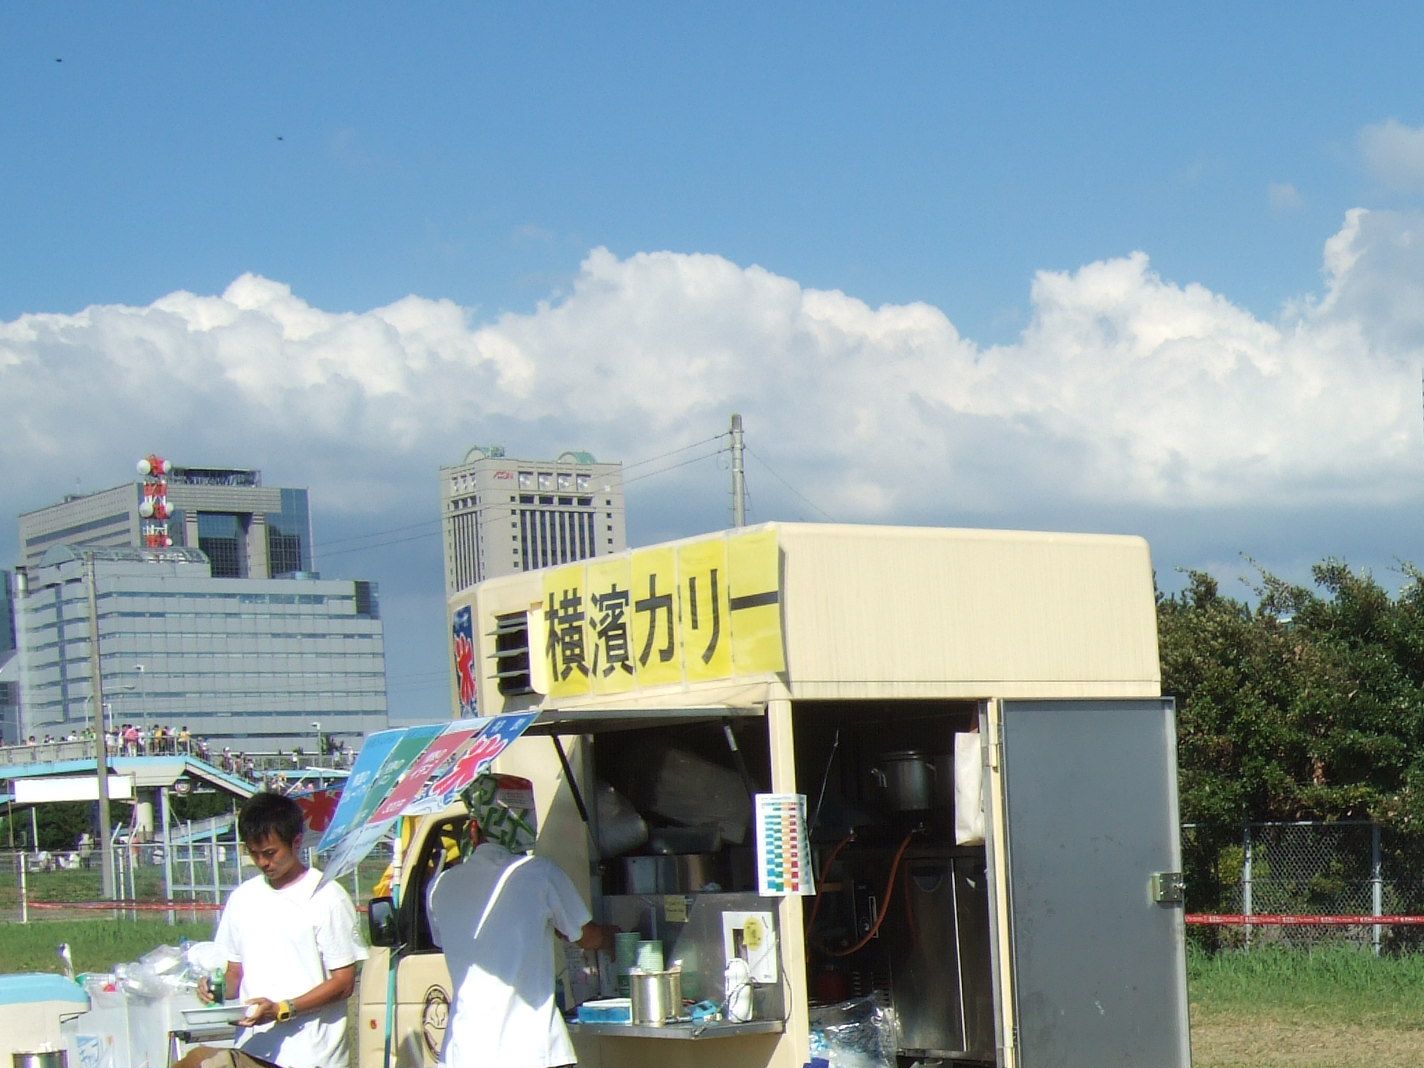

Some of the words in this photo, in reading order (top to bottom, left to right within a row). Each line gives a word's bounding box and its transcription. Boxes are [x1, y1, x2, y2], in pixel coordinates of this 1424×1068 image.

[543, 567, 779, 683] 横濱カリー
